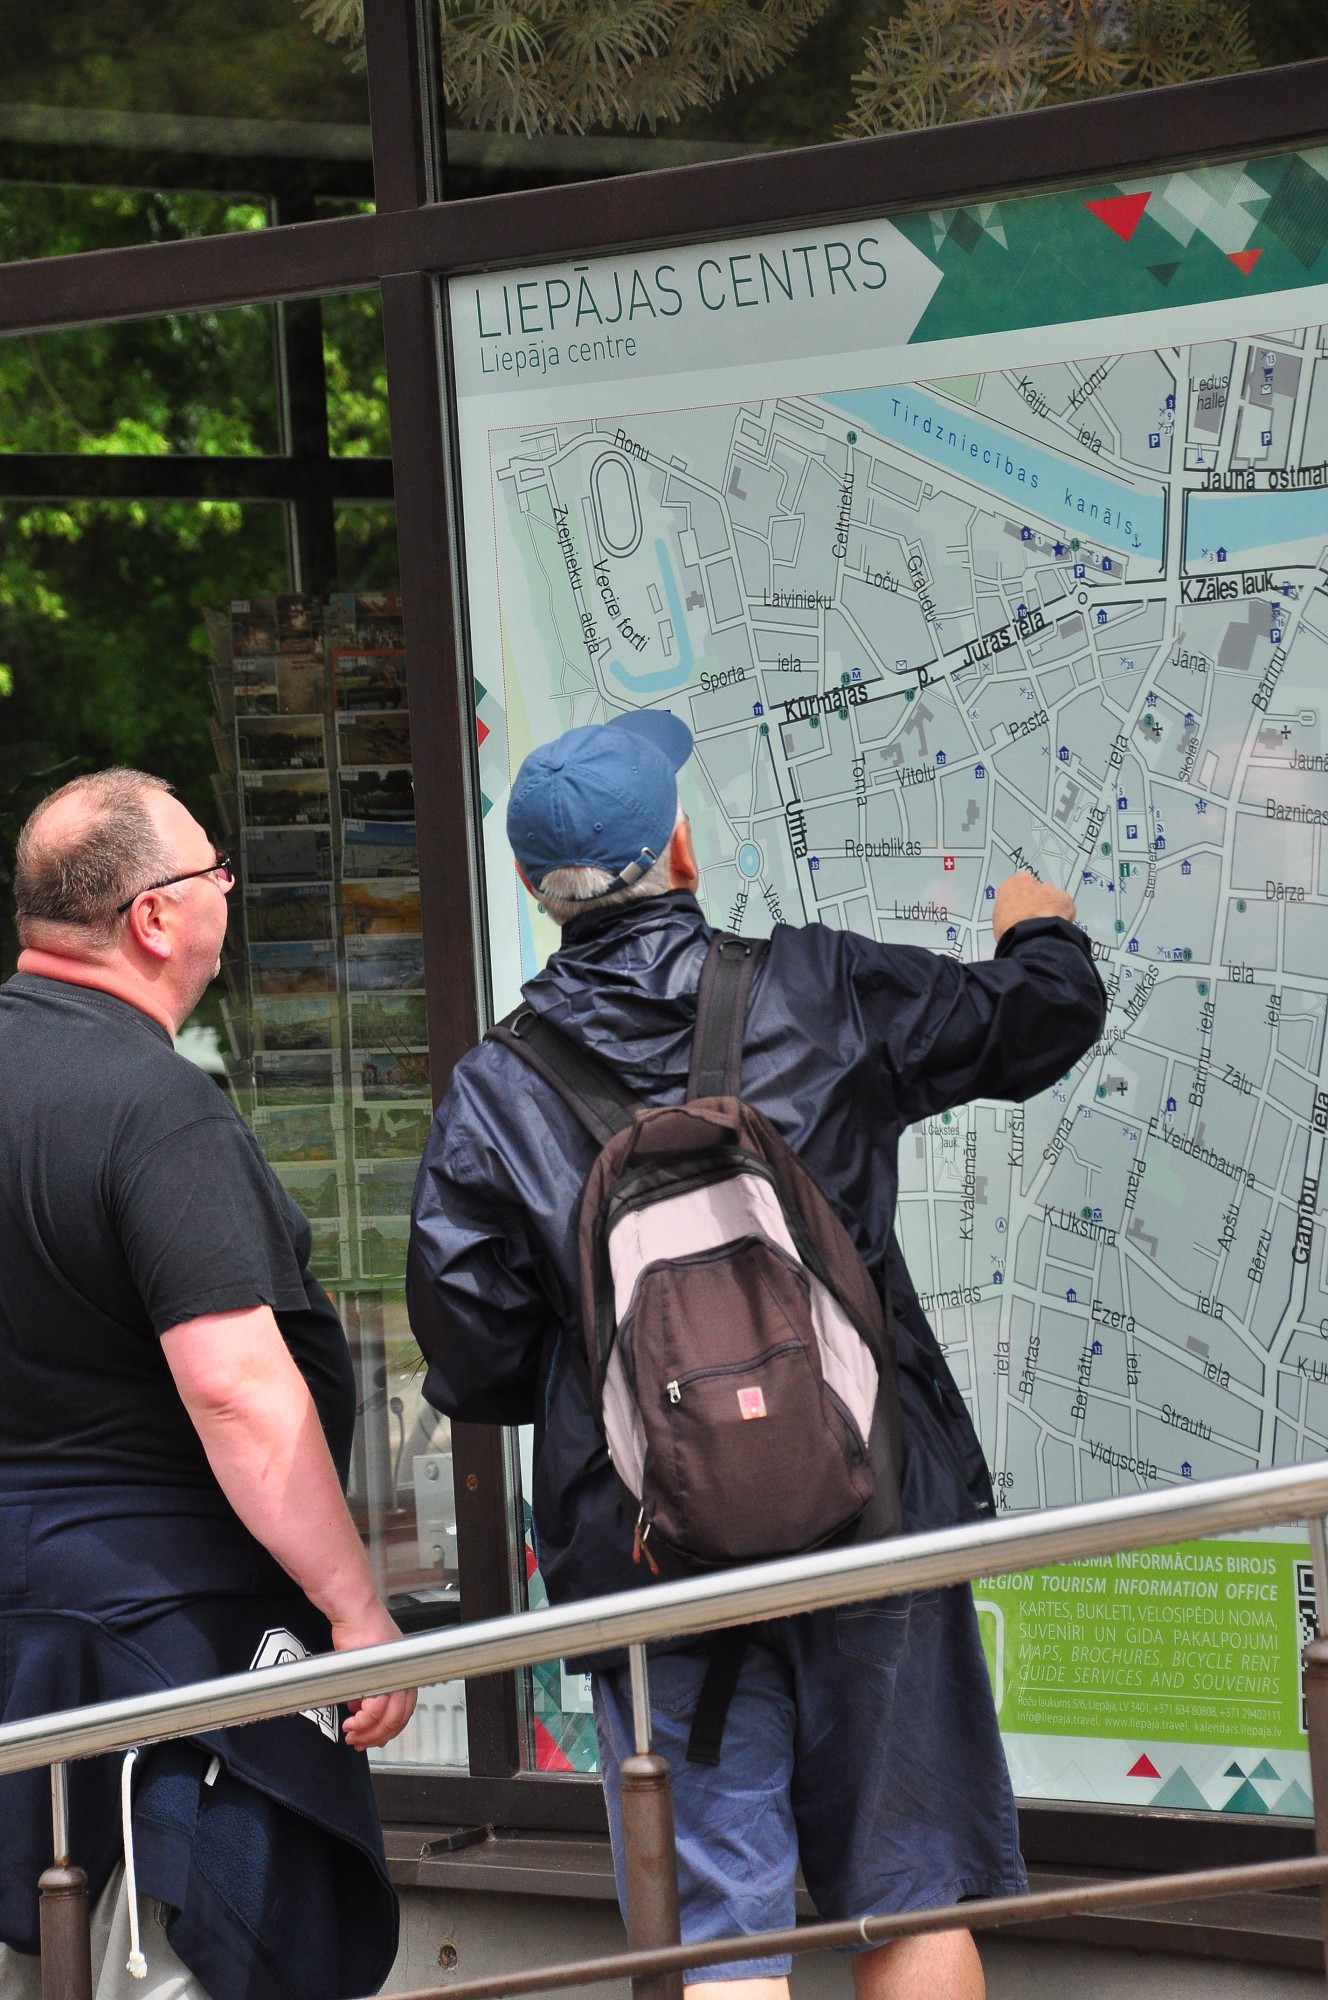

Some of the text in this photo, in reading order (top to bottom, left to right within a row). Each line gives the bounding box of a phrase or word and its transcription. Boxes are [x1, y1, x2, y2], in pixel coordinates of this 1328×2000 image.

[476, 237, 888, 338] LIEPĀJAS CENTRS
[481, 334, 637, 377] Liepāja centre
[1267, 353, 1275, 364] 13
[1191, 373, 1229, 393] Ledus
[1018, 375, 1103, 455] Kaiju iela
[1197, 393, 1226, 412] halle
[891, 398, 1133, 535] Tirdzniecības kanāls
[831, 472, 855, 559] Celtnieku
[553, 503, 603, 655] Zvejnieku aleja
[594, 558, 623, 617] Vecie
[865, 565, 900, 594] Loču
[907, 555, 938, 624] Graudu
[763, 587, 832, 610] Laivinieku
[1011, 611, 1045, 641] iela
[700, 653, 802, 693] Sporta iela
[1171, 647, 1208, 676] Jāņa
[1008, 708, 1050, 741] Pasta
[1104, 733, 1130, 771] iela
[1178, 737, 1199, 783] Skolas
[851, 757, 867, 807] Toma
[895, 762, 936, 788] Vītolu
[845, 837, 922, 863] Republikas
[1144, 841, 1158, 899] Stendera
[1265, 880, 1305, 902] Dārza
[1228, 959, 1255, 985] iela
[1123, 963, 1160, 1022] Malkas
[1196, 1001, 1215, 1035] iela
[1263, 994, 1282, 1028] iela
[1007, 1108, 1025, 1168] Kuršu
[1042, 1116, 1074, 1166] Siena
[1217, 1203, 1240, 1253] Apšu
[1247, 1228, 1272, 1284] Bērzu
[916, 1283, 982, 1312] ūrmalas
[1197, 1290, 1225, 1320] iela
[993, 1340, 1010, 1376] iela
[1091, 1299, 1231, 1388] Ezera iela
[1018, 1334, 1041, 1395] Bārtas
[1126, 1352, 1142, 1386] iela
[1070, 1346, 1095, 1420] Bernātu
[1160, 1404, 1213, 1441] Strautu
[1226, 1556, 1277, 1575] BIROJS
[1041, 1575, 1107, 1594] TOURISM
[1114, 1578, 1219, 1599] INFORMATION
[1226, 1583, 1279, 1601] OFFICE
[1019, 1600, 1073, 1621] KARTES,
[1229, 1609, 1278, 1631] NOMA,
[1095, 1626, 1116, 1643] UN
[1126, 1627, 1164, 1645] GIDA
[1173, 1629, 1279, 1651] PAKALPOJUMI
[1018, 1643, 1281, 1673] MAPS, BROCHURES, BICYCLE RENT
[1019, 1664, 1280, 1695] GUIDE SERVICES AND SOUVENIRS
